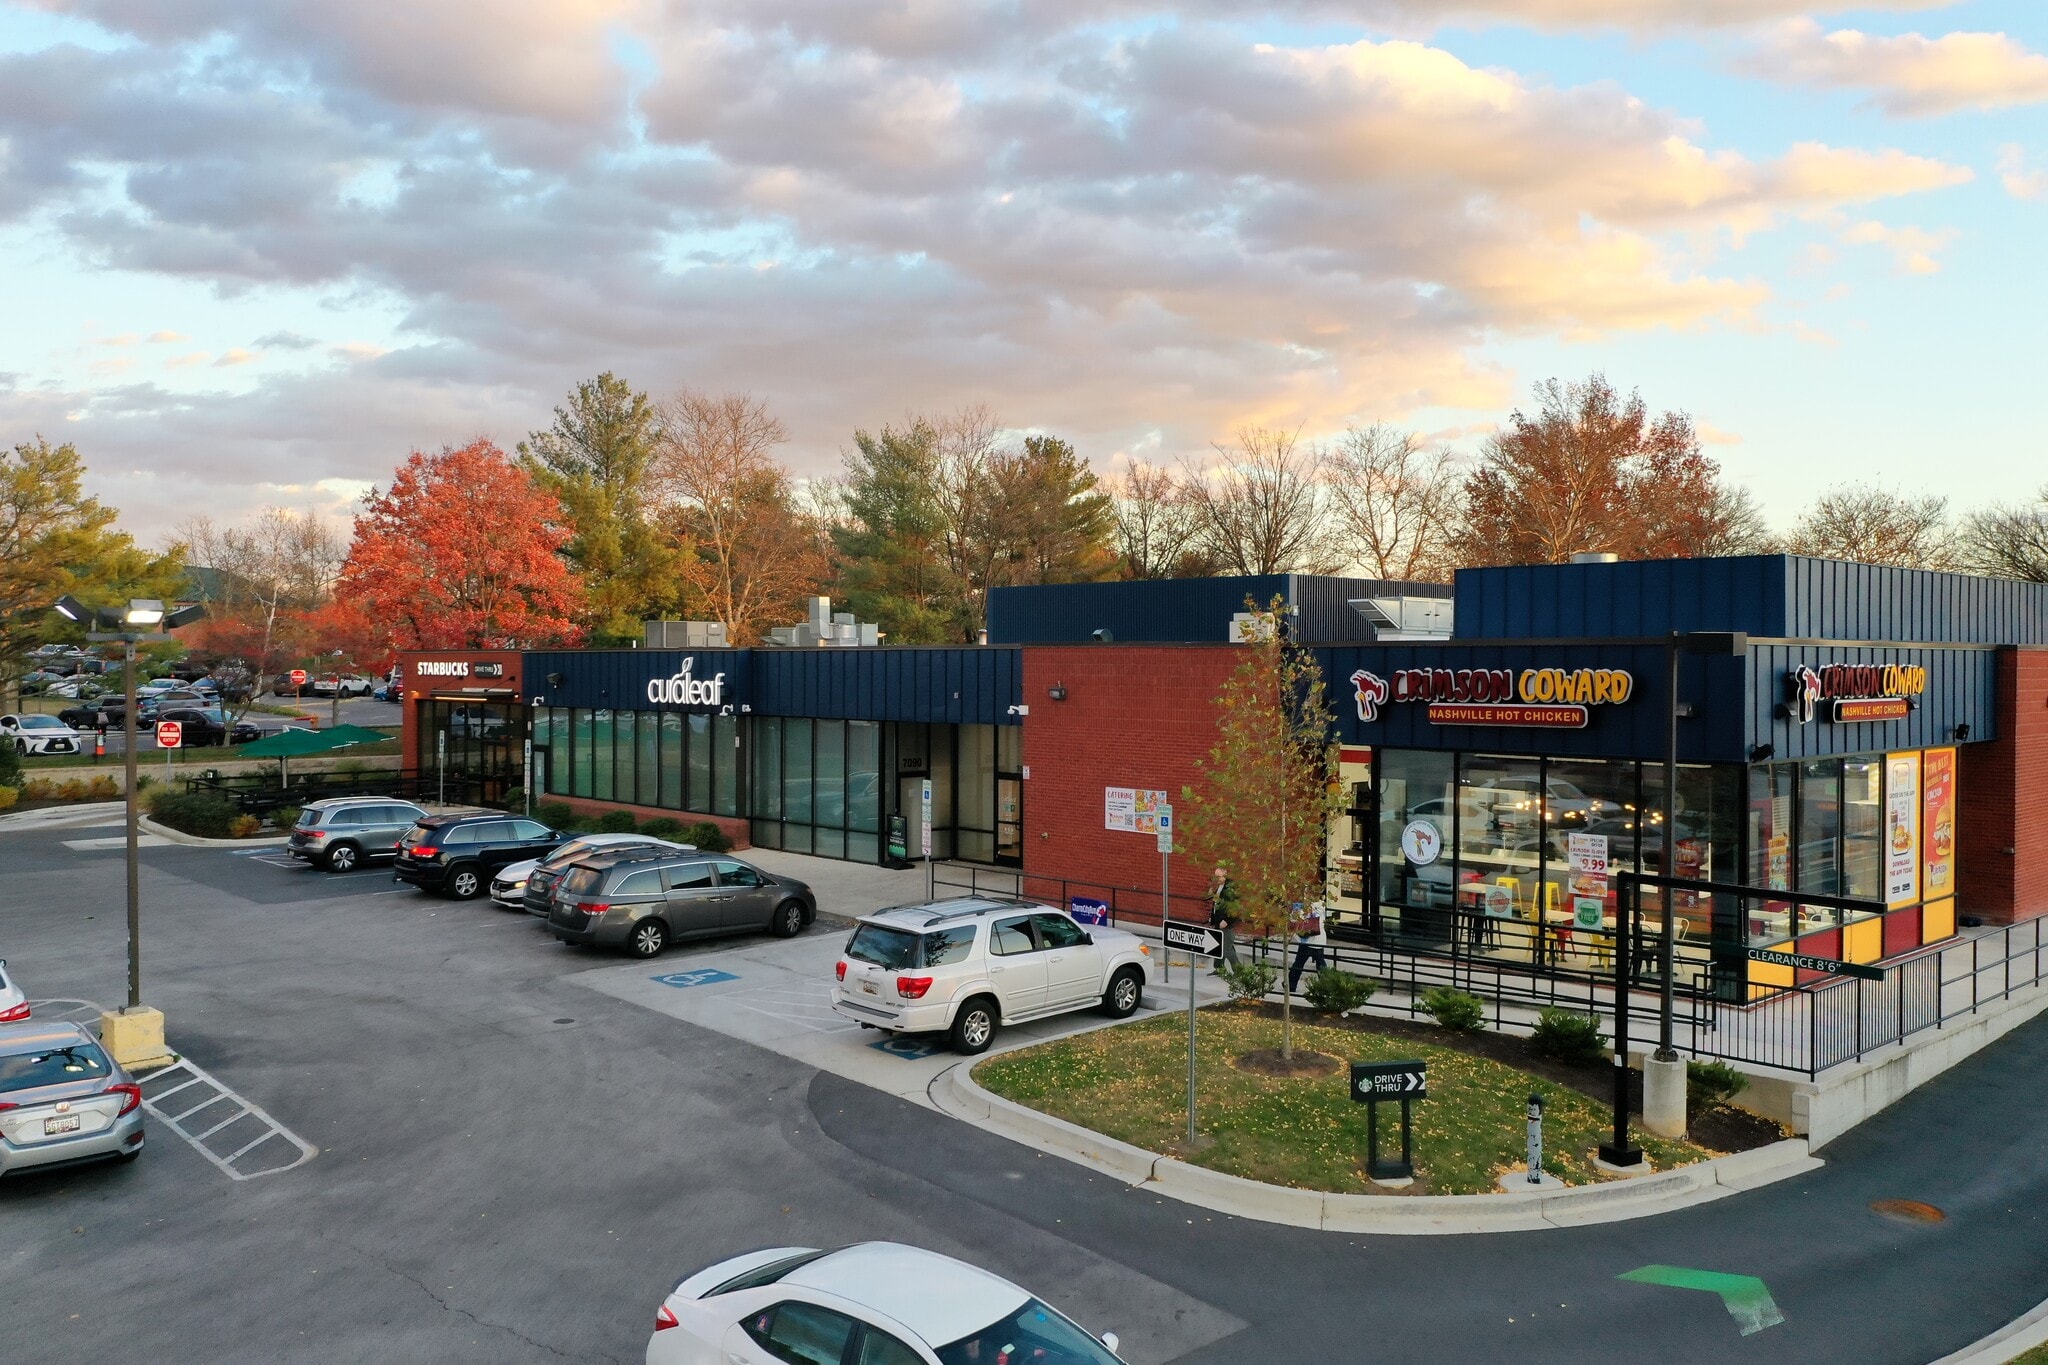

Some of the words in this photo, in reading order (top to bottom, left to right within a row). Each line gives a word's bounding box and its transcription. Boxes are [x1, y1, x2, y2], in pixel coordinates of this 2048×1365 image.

[417, 661, 469, 676] STARBUCKS
[648, 658, 725, 705] curaleaf
[1518, 668, 1634, 704] COWARD
[1882, 664, 1927, 697] COWARD
[1429, 709, 1493, 721] NASHVILLE
[1496, 710, 1520, 721] HOT
[1524, 711, 1581, 723] CHICKEN
[1841, 705, 1872, 717] NASHVILLE
[1872, 704, 1884, 715] HOT
[1883, 703, 1907, 715] CHICKEN
[1107, 791, 1134, 800] CATERING
[1169, 929, 1186, 943] ONE
[1187, 933, 1205, 946] WAY
[1747, 949, 1814, 969] CLEARANCE
[1374, 1073, 1403, 1084] DRIVE
[1374, 1083, 1401, 1093] THRU
